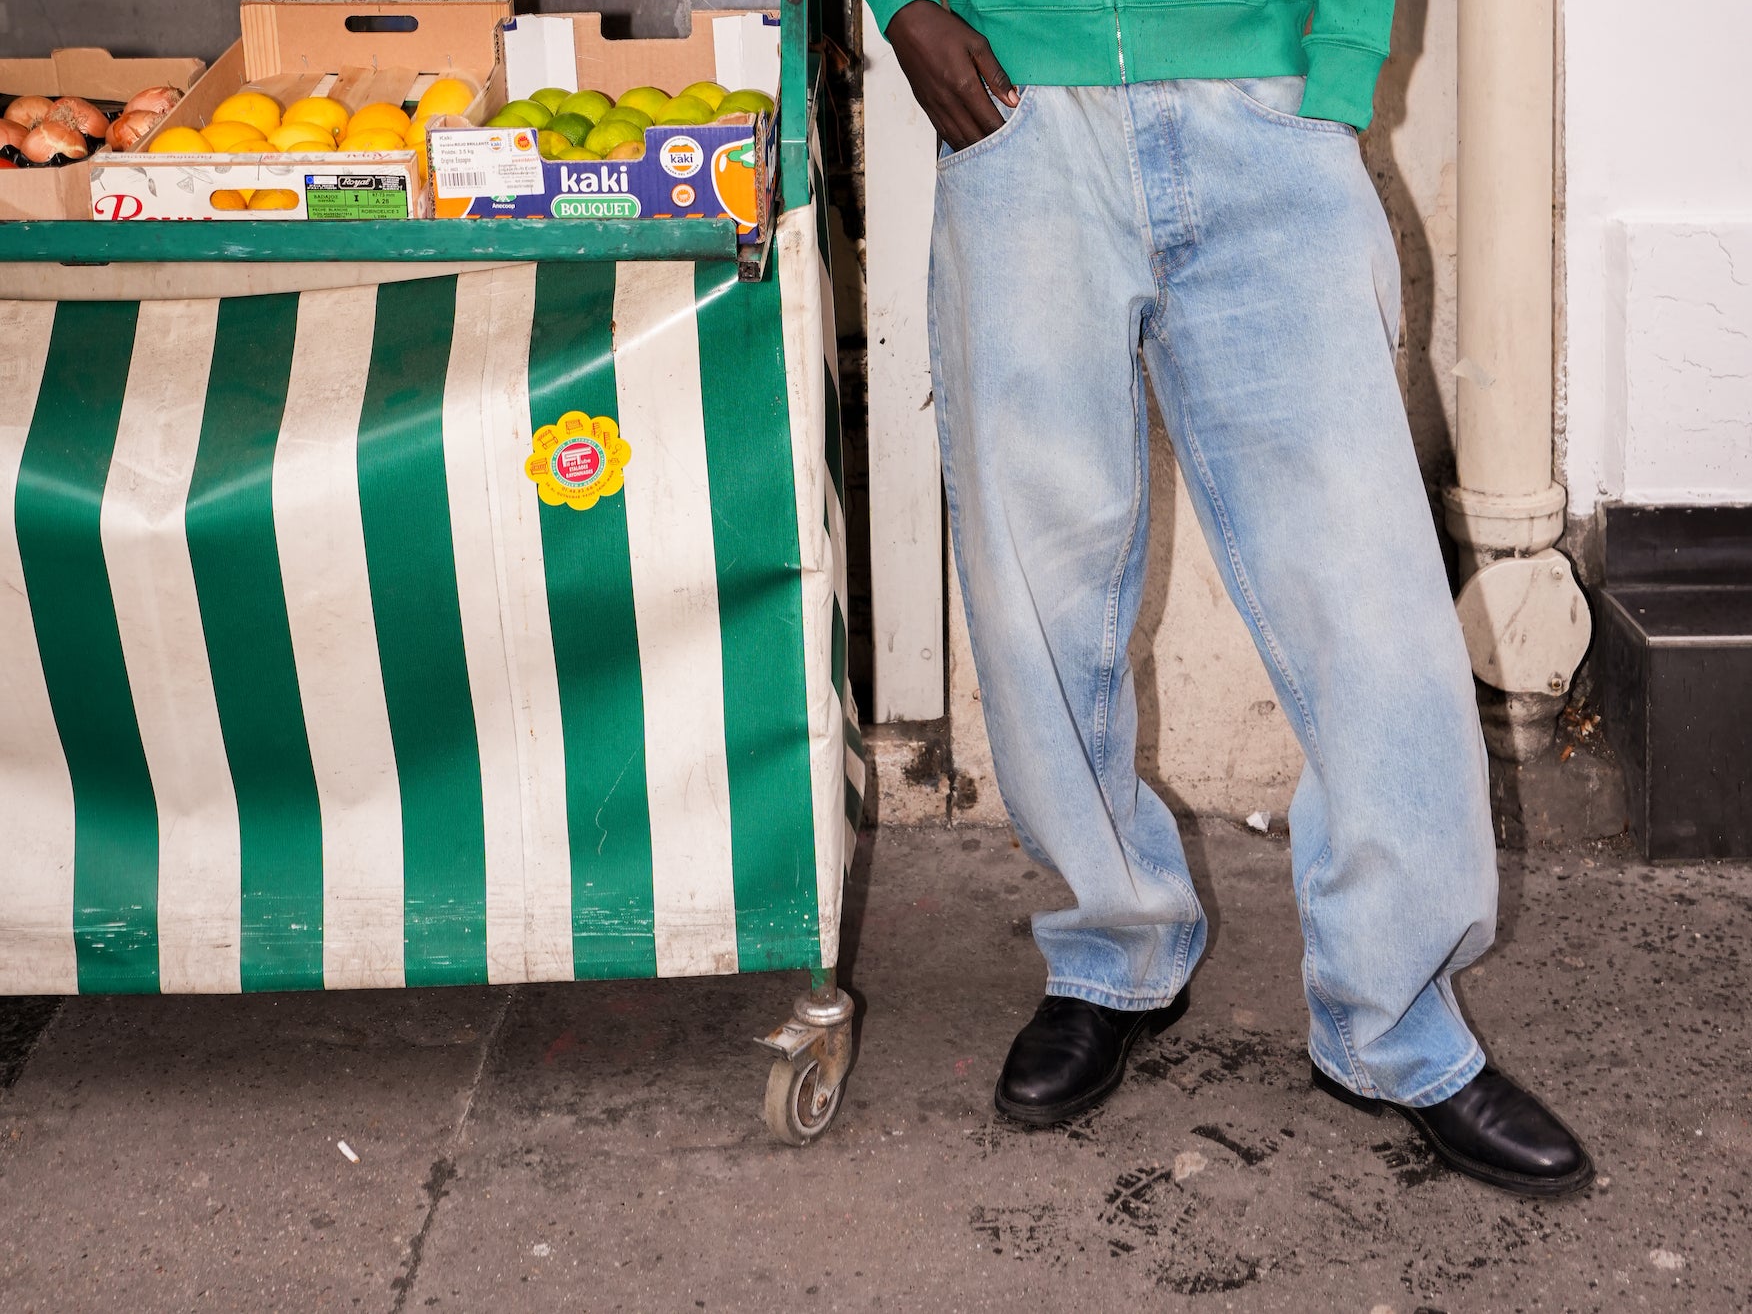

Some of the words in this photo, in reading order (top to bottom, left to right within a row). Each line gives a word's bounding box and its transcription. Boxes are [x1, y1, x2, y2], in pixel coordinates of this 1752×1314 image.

[670, 153, 694, 164] kaki
[342, 177, 371, 188] Royal
[561, 166, 629, 193] kaki
[560, 202, 632, 218] BOUQUET
